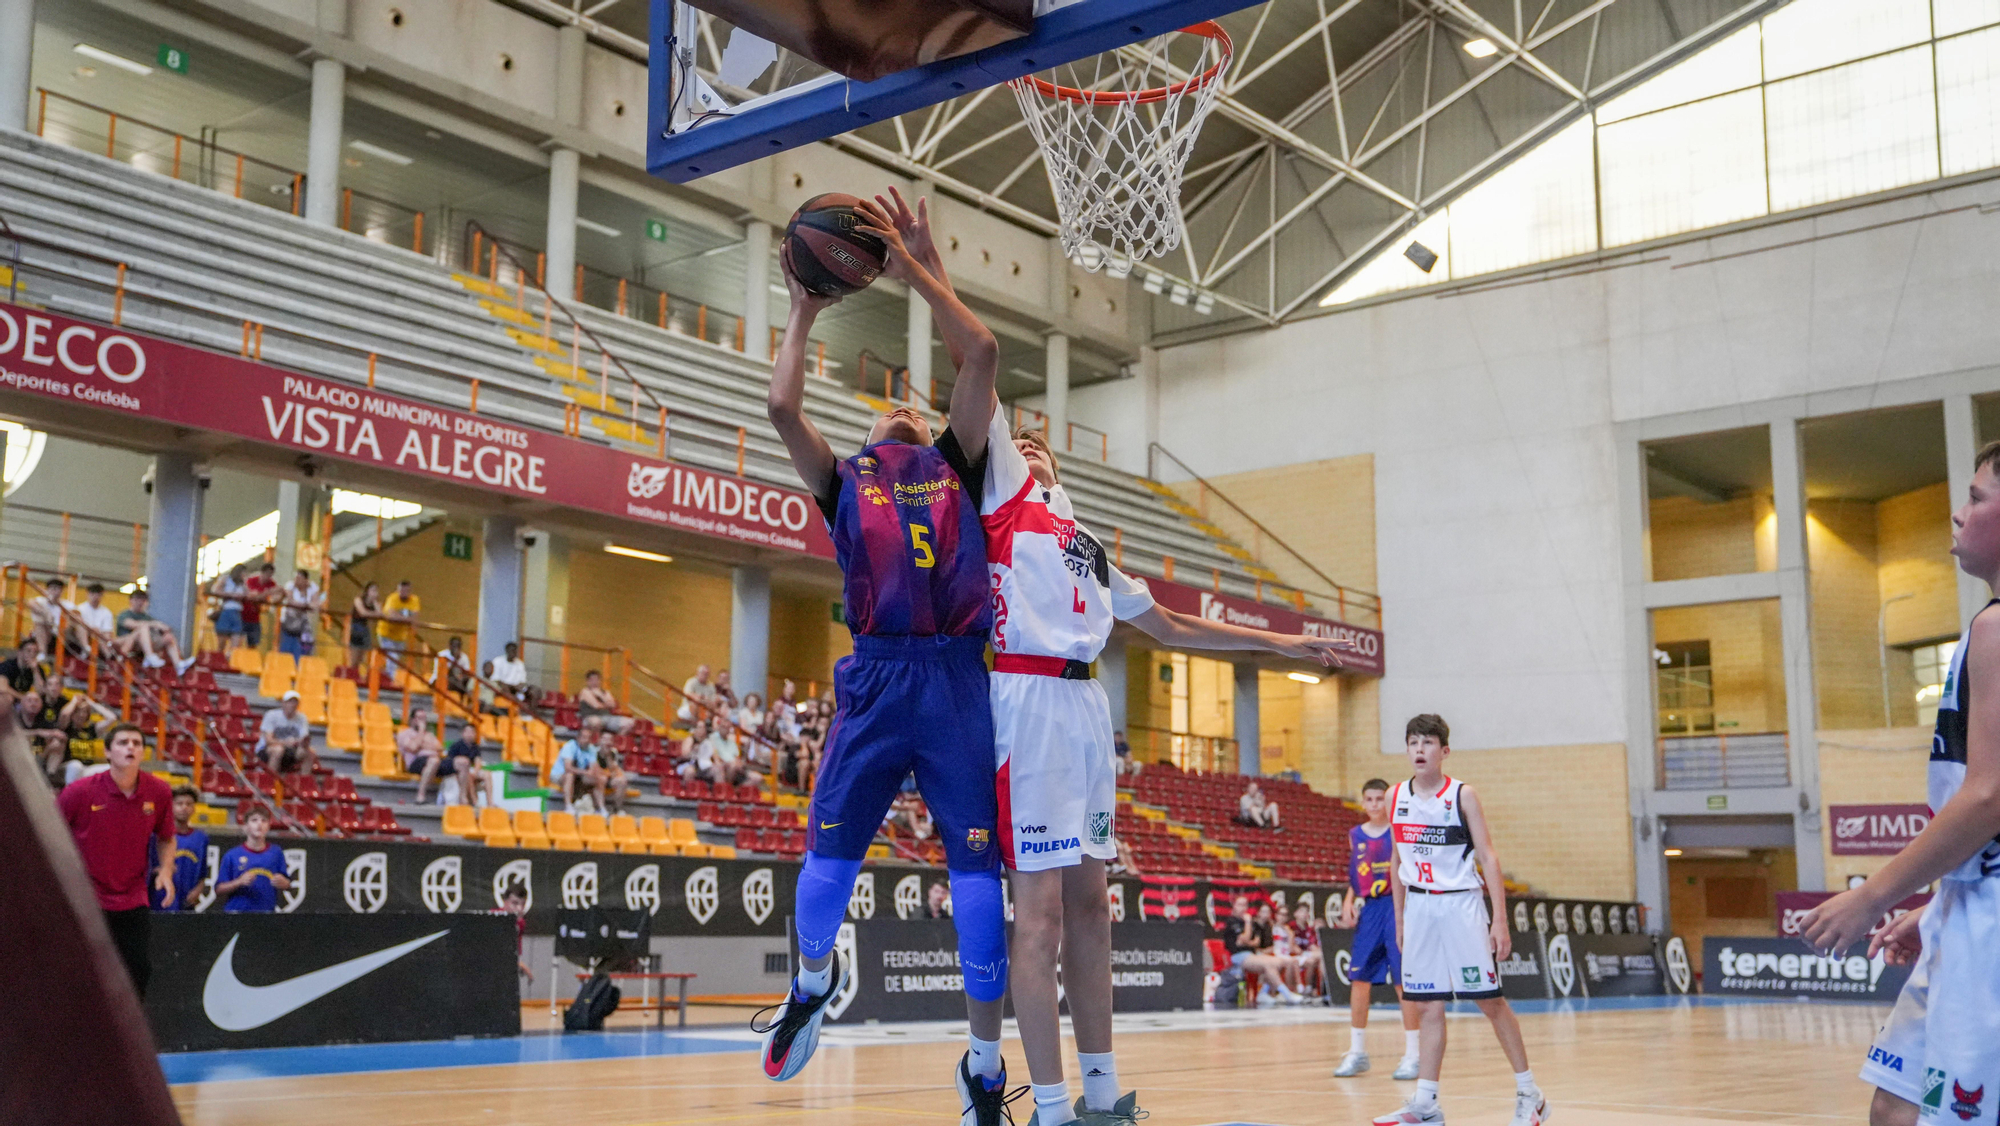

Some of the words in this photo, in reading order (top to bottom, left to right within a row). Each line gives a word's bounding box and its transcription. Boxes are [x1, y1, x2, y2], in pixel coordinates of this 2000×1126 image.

[73, 382, 140, 411] Córdoba
[283, 376, 360, 410] PALACIO
[363, 395, 451, 432] MUNICIPAL
[454, 417, 529, 449] DEPORTES
[261, 395, 383, 461] VISTA
[395, 429, 547, 494] ALEGRE
[672, 468, 808, 532] IMDECO
[451, 536, 466, 557] H
[909, 523, 936, 569] 5
[1020, 824, 1047, 834] vive
[1021, 837, 1081, 854] PULEVA
[1412, 845, 1433, 856] 2031
[882, 948, 954, 968] FEDERACIÓN
[884, 975, 902, 992] DE
[1720, 977, 1787, 991] despierta
[1790, 979, 1867, 993] emociones
